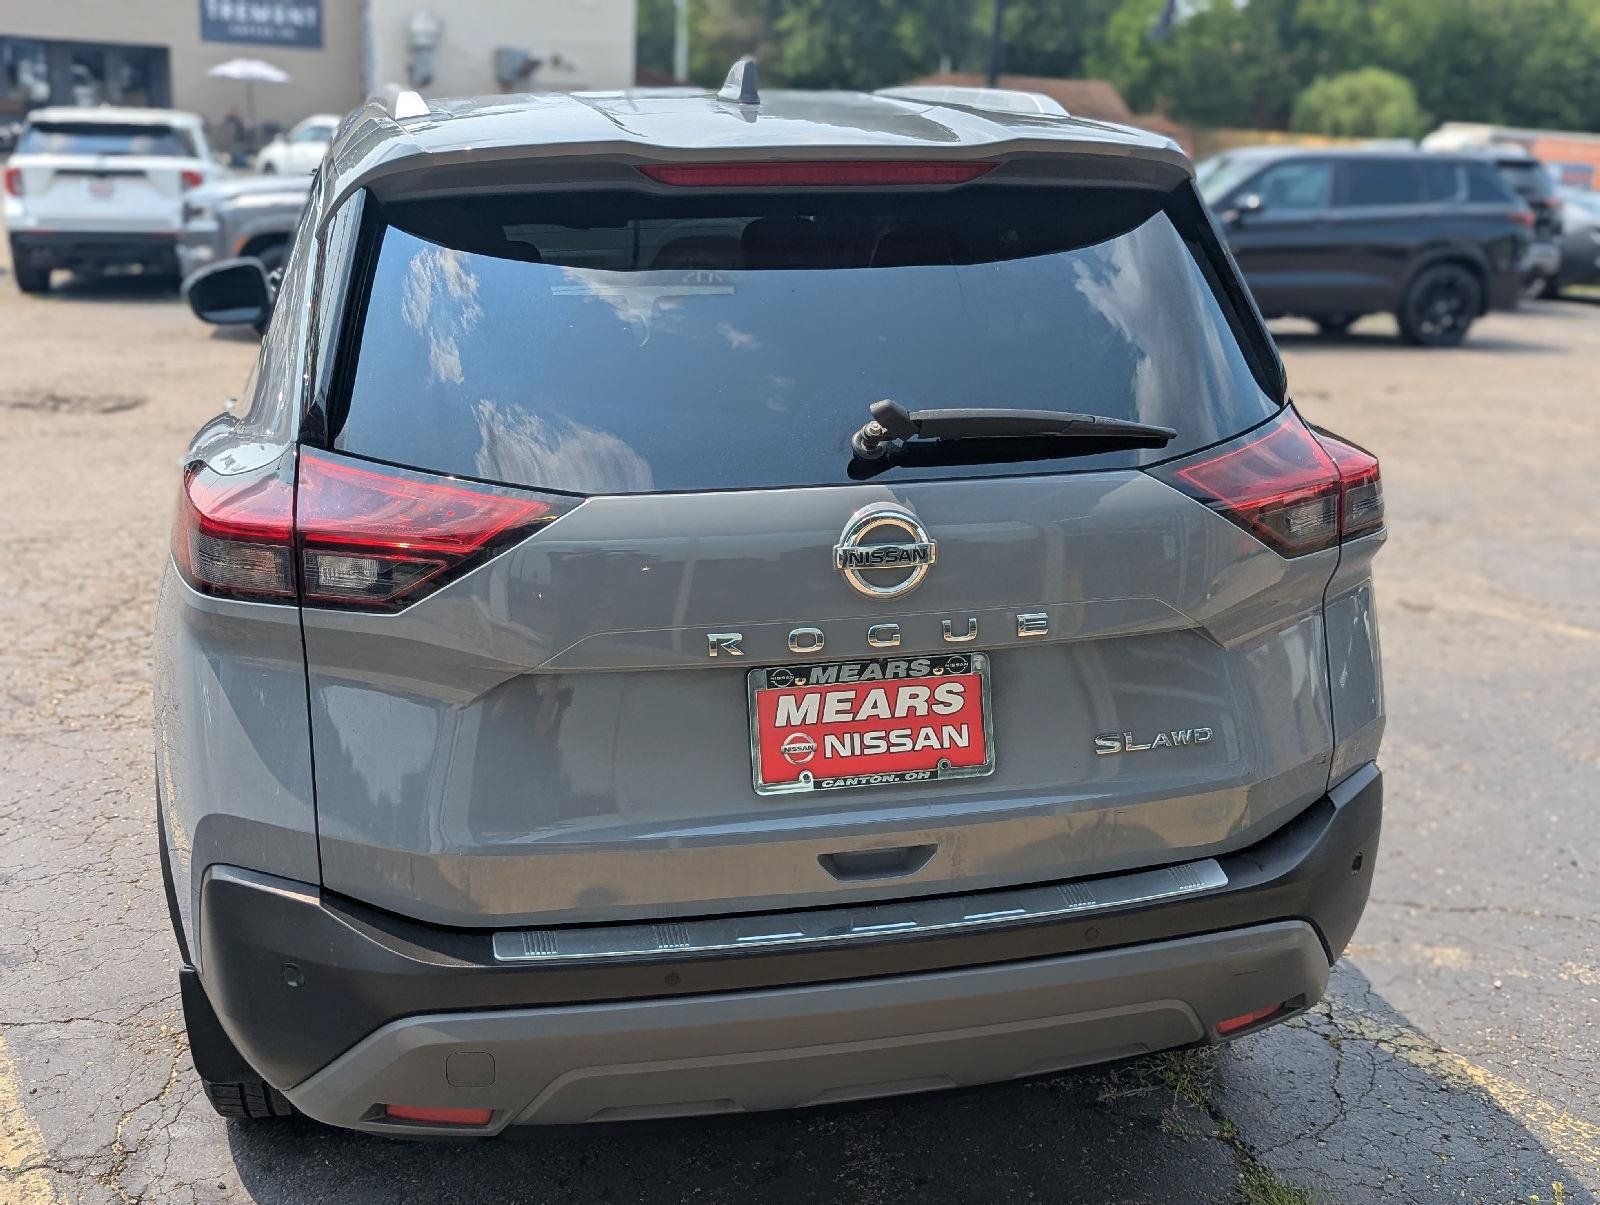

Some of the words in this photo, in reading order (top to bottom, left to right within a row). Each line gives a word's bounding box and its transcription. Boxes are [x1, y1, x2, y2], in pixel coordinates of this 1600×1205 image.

[846, 547, 928, 565] NISSAN
[707, 612, 1049, 657] ROGUE
[809, 659, 931, 685] MEARS
[775, 682, 966, 728] MEARS
[784, 744, 813, 754] NISSAN
[825, 725, 969, 759] NISSAN
[1094, 731, 1151, 755] SL
[1151, 727, 1213, 749] AWD
[905, 771, 931, 781] OH
